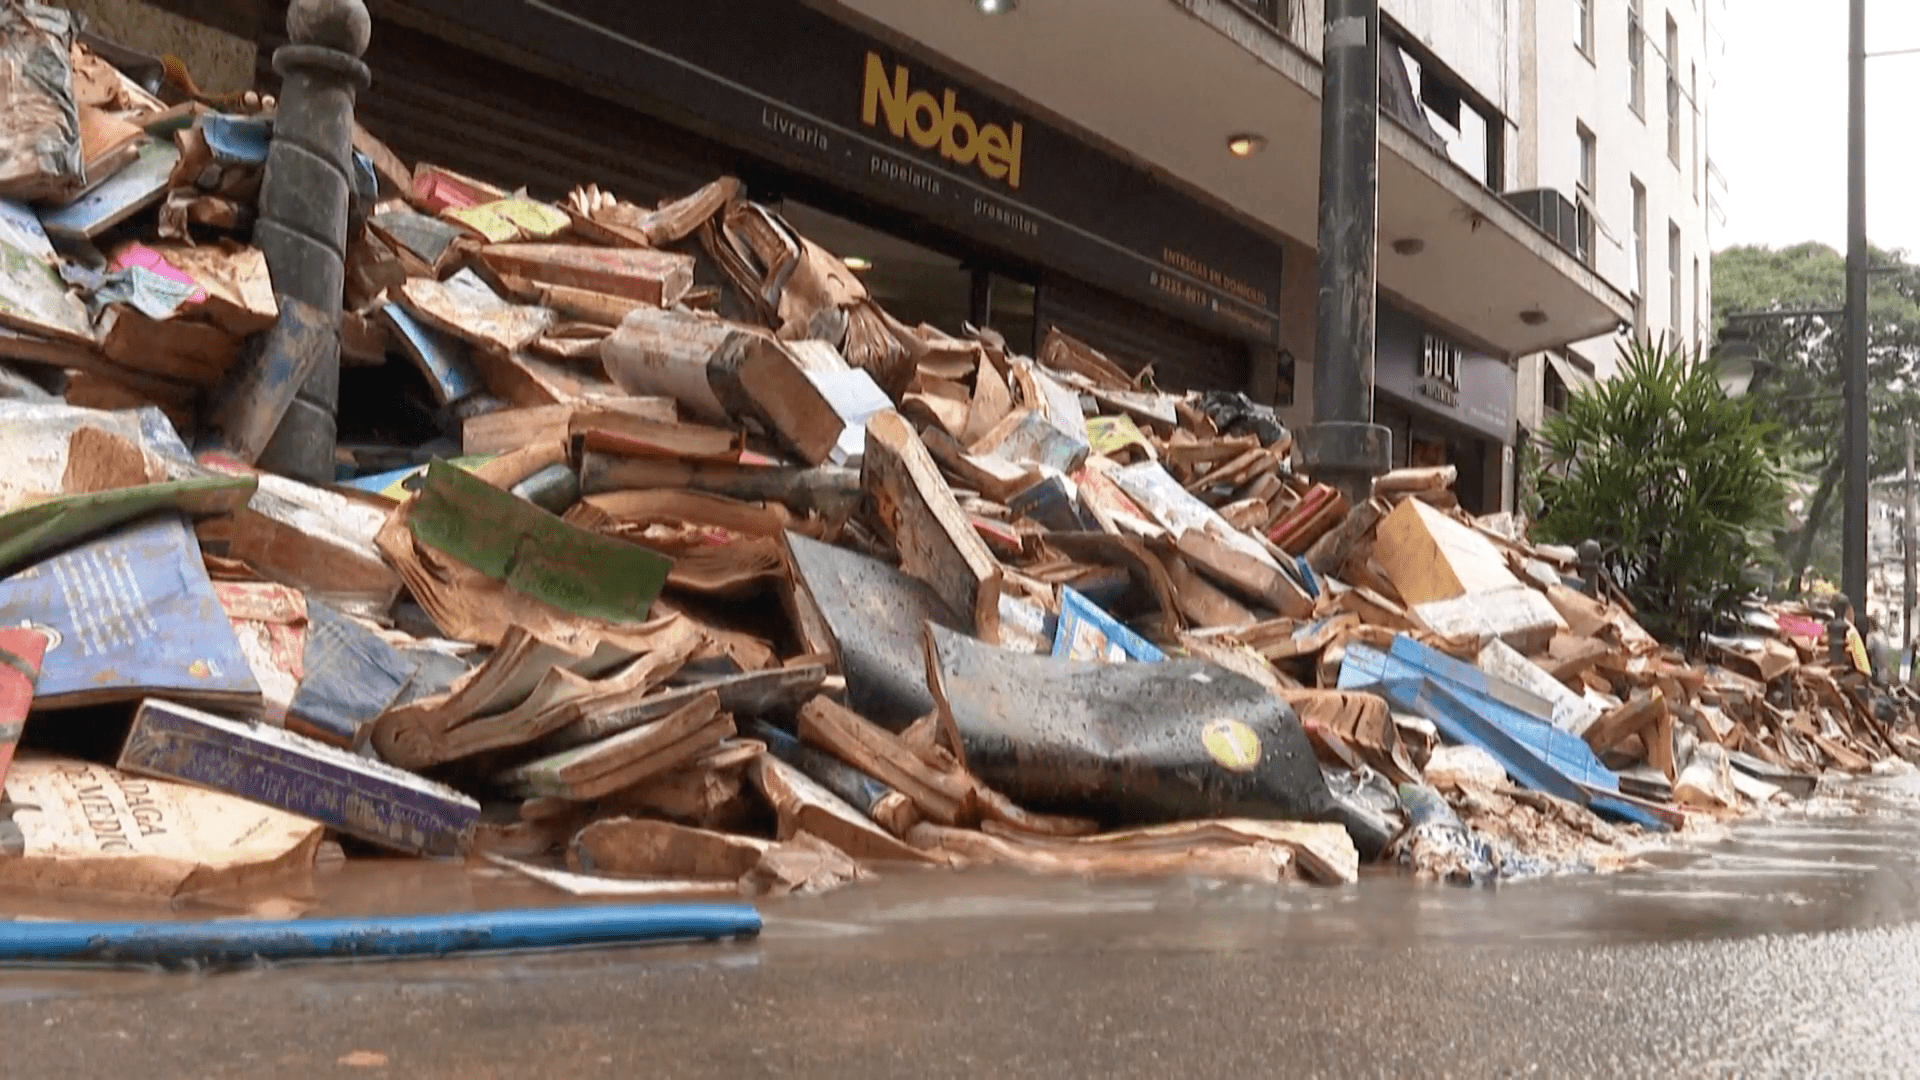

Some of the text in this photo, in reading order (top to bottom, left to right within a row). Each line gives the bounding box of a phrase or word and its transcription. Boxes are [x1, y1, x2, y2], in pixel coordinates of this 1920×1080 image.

[762, 106, 1039, 236] Livraria papelaria presentes
[862, 51, 1023, 188] Nobel
[1423, 335, 1461, 392] BULK
